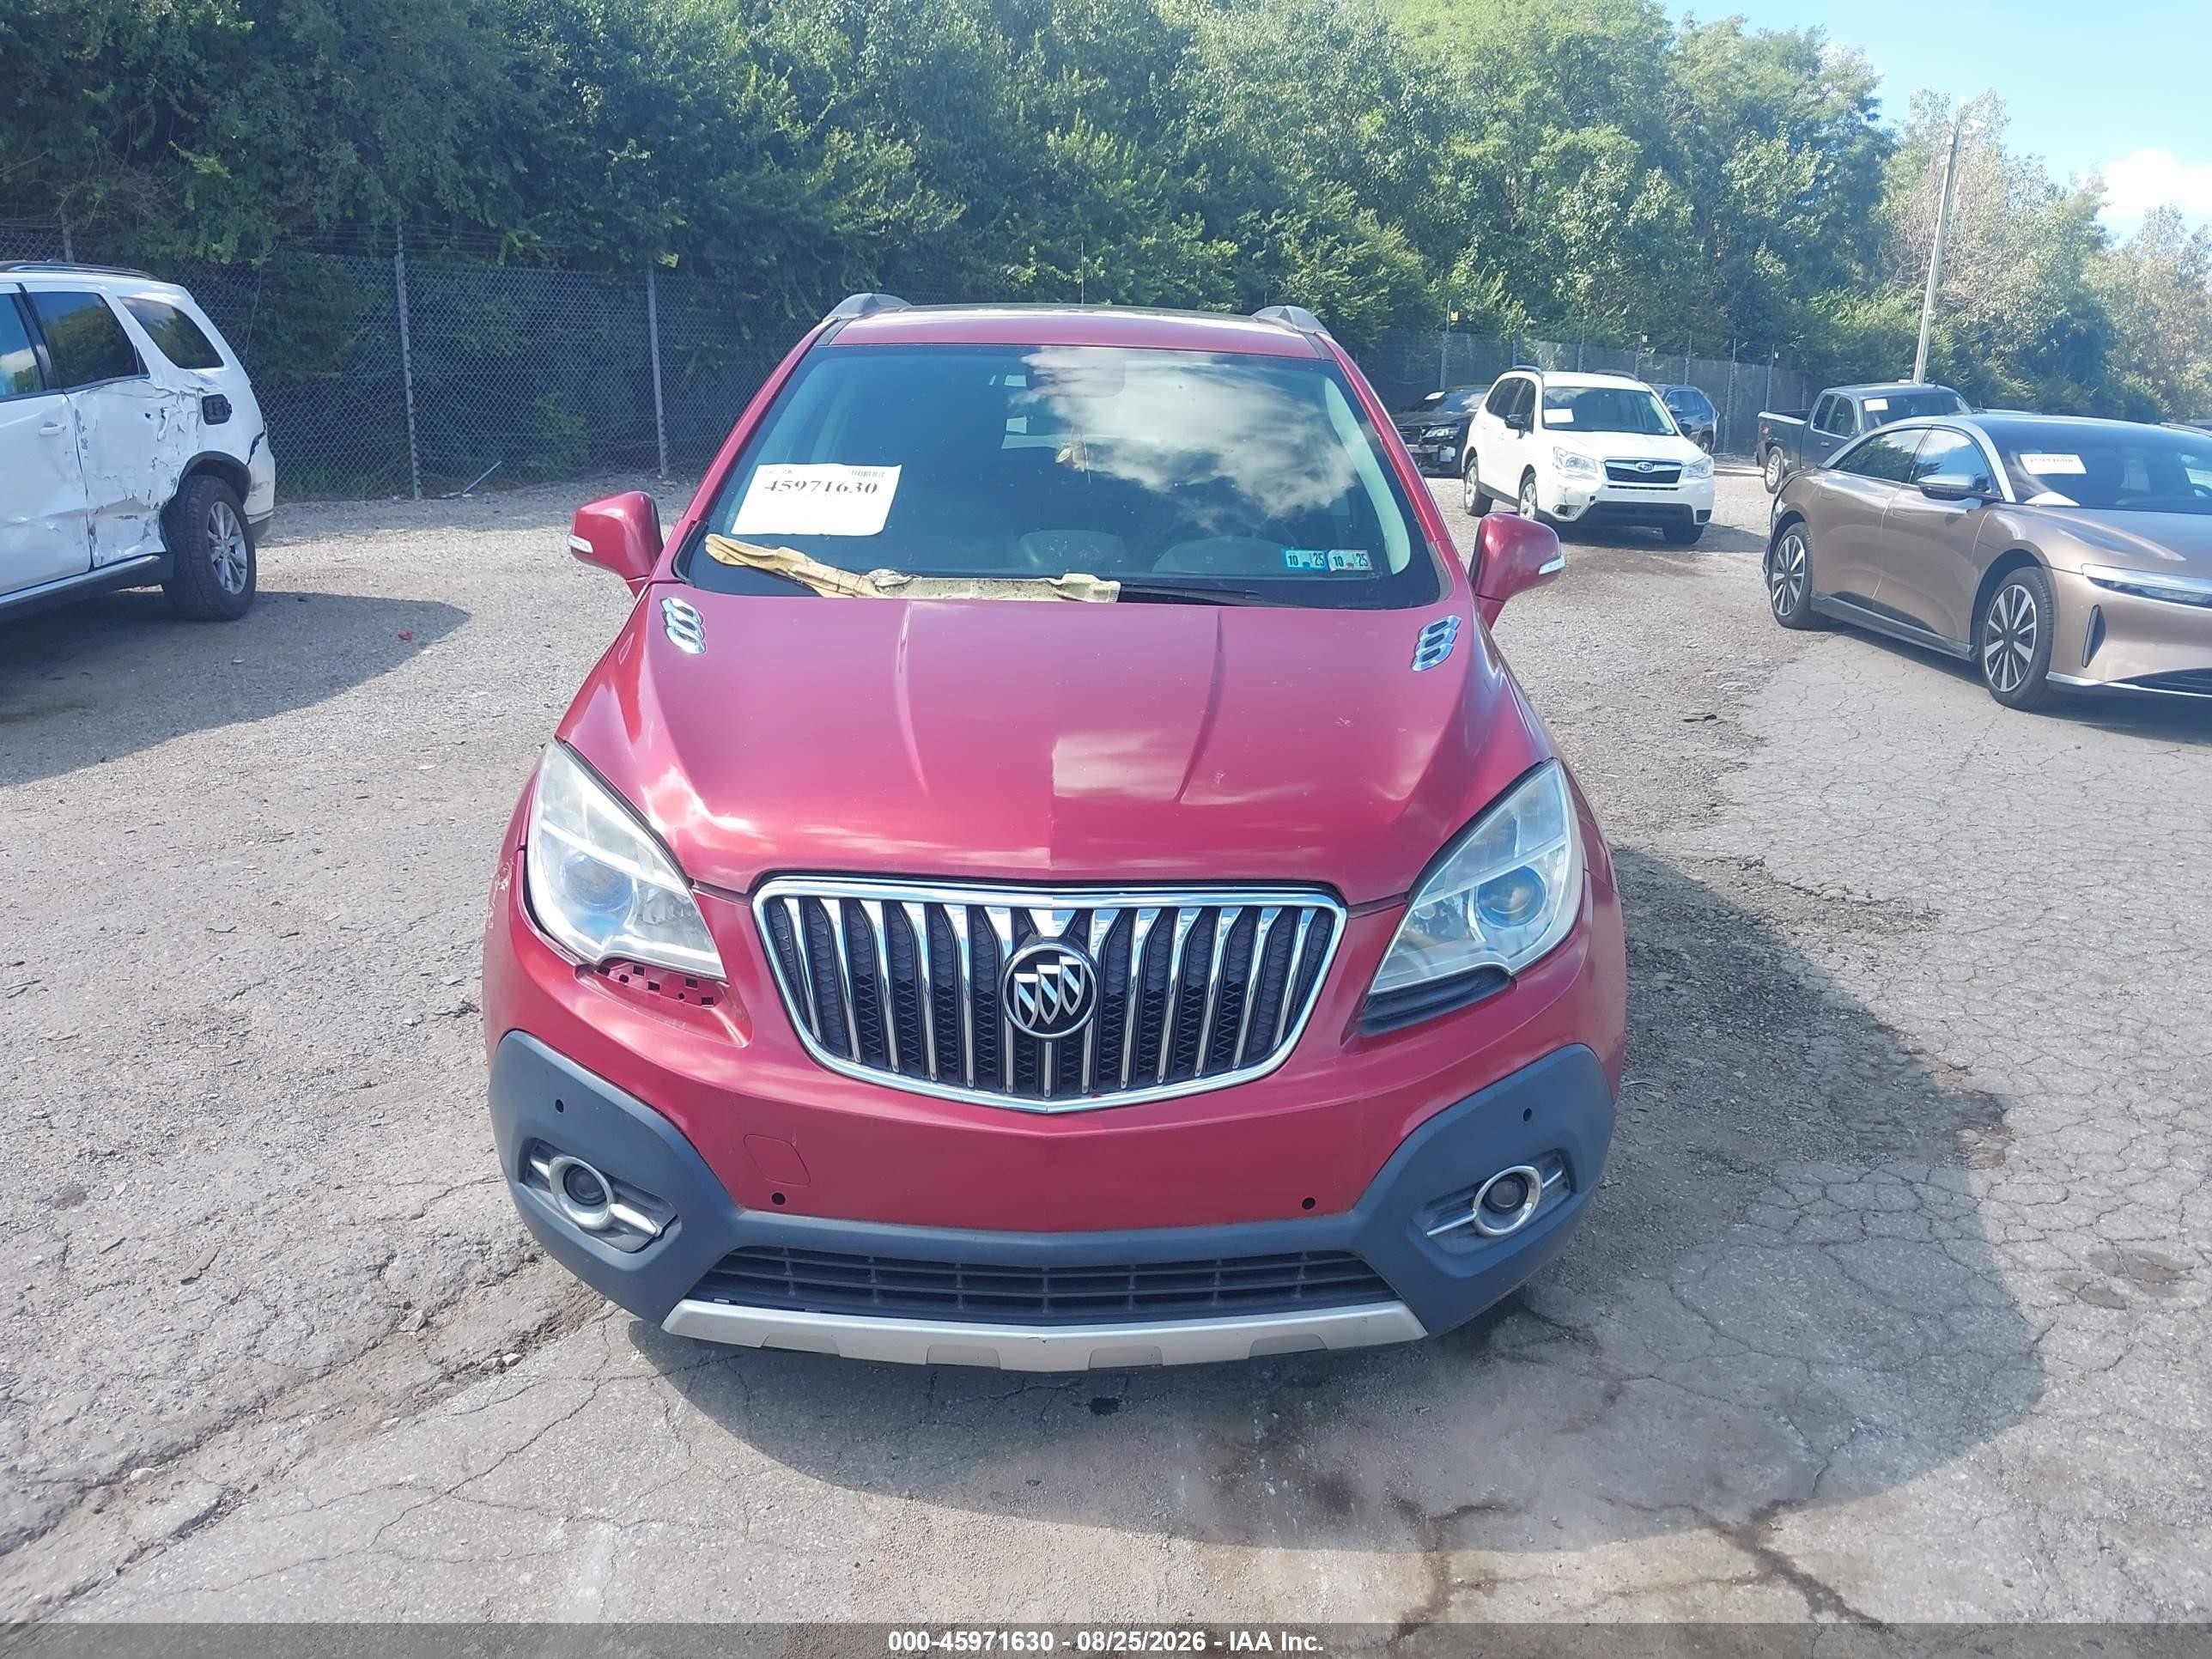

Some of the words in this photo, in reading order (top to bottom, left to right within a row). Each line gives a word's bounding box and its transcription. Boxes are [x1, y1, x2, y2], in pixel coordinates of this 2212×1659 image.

[763, 479, 878, 495] 45971630
[1288, 555, 1298, 566] 10
[1313, 553, 1325, 567] 25
[1333, 556, 1344, 567] 10
[1356, 553, 1369, 567] 25
